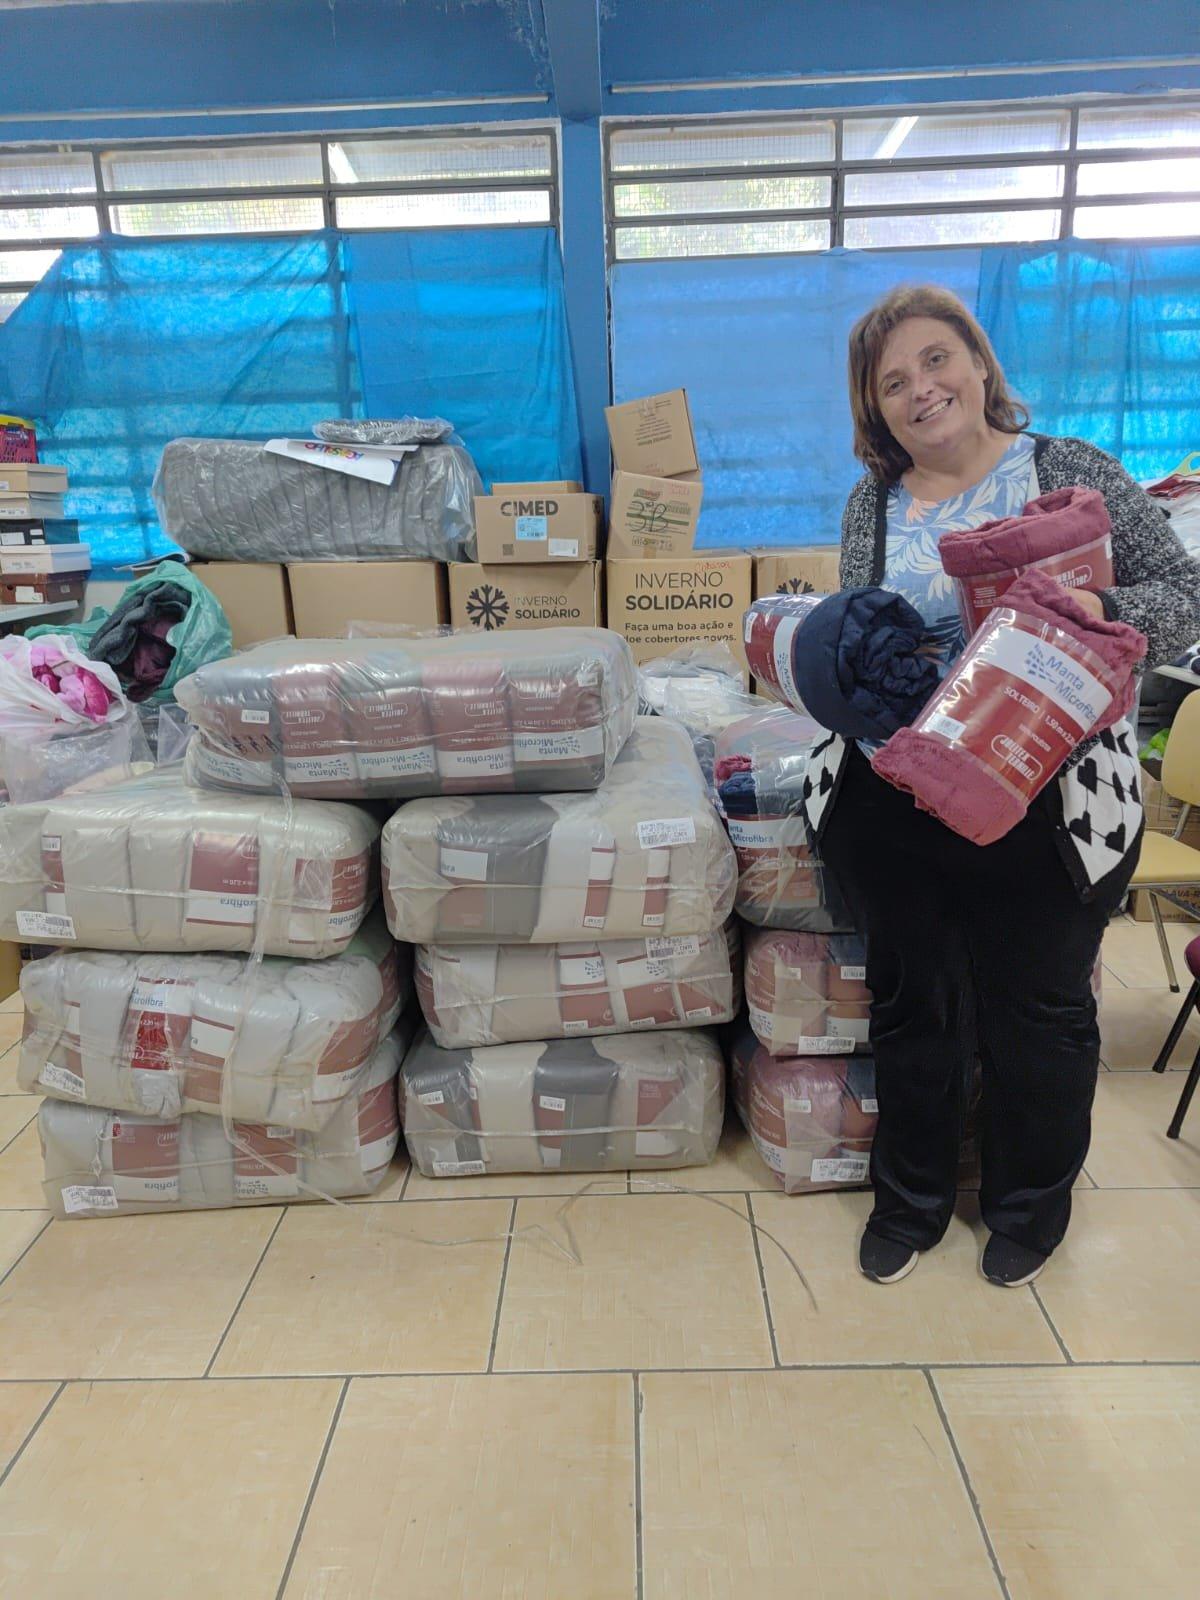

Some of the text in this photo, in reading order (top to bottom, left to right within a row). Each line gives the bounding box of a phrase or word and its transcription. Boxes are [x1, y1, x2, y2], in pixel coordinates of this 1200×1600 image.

[501, 500, 559, 516] CIMED
[635, 571, 723, 589] INVERNO
[514, 595, 568, 606] INVERNO
[625, 590, 734, 611] SOLIDÁRIO
[515, 607, 580, 619] SOLIDÁRIO
[625, 622, 649, 632] Faça
[652, 623, 674, 631] uma
[677, 622, 697, 630] boa
[700, 621, 725, 631] ação
[1046, 655, 1086, 692] Manta
[538, 747, 569, 756] Manta
[456, 753, 505, 765] Microfibra
[308, 768, 339, 778] Manta
